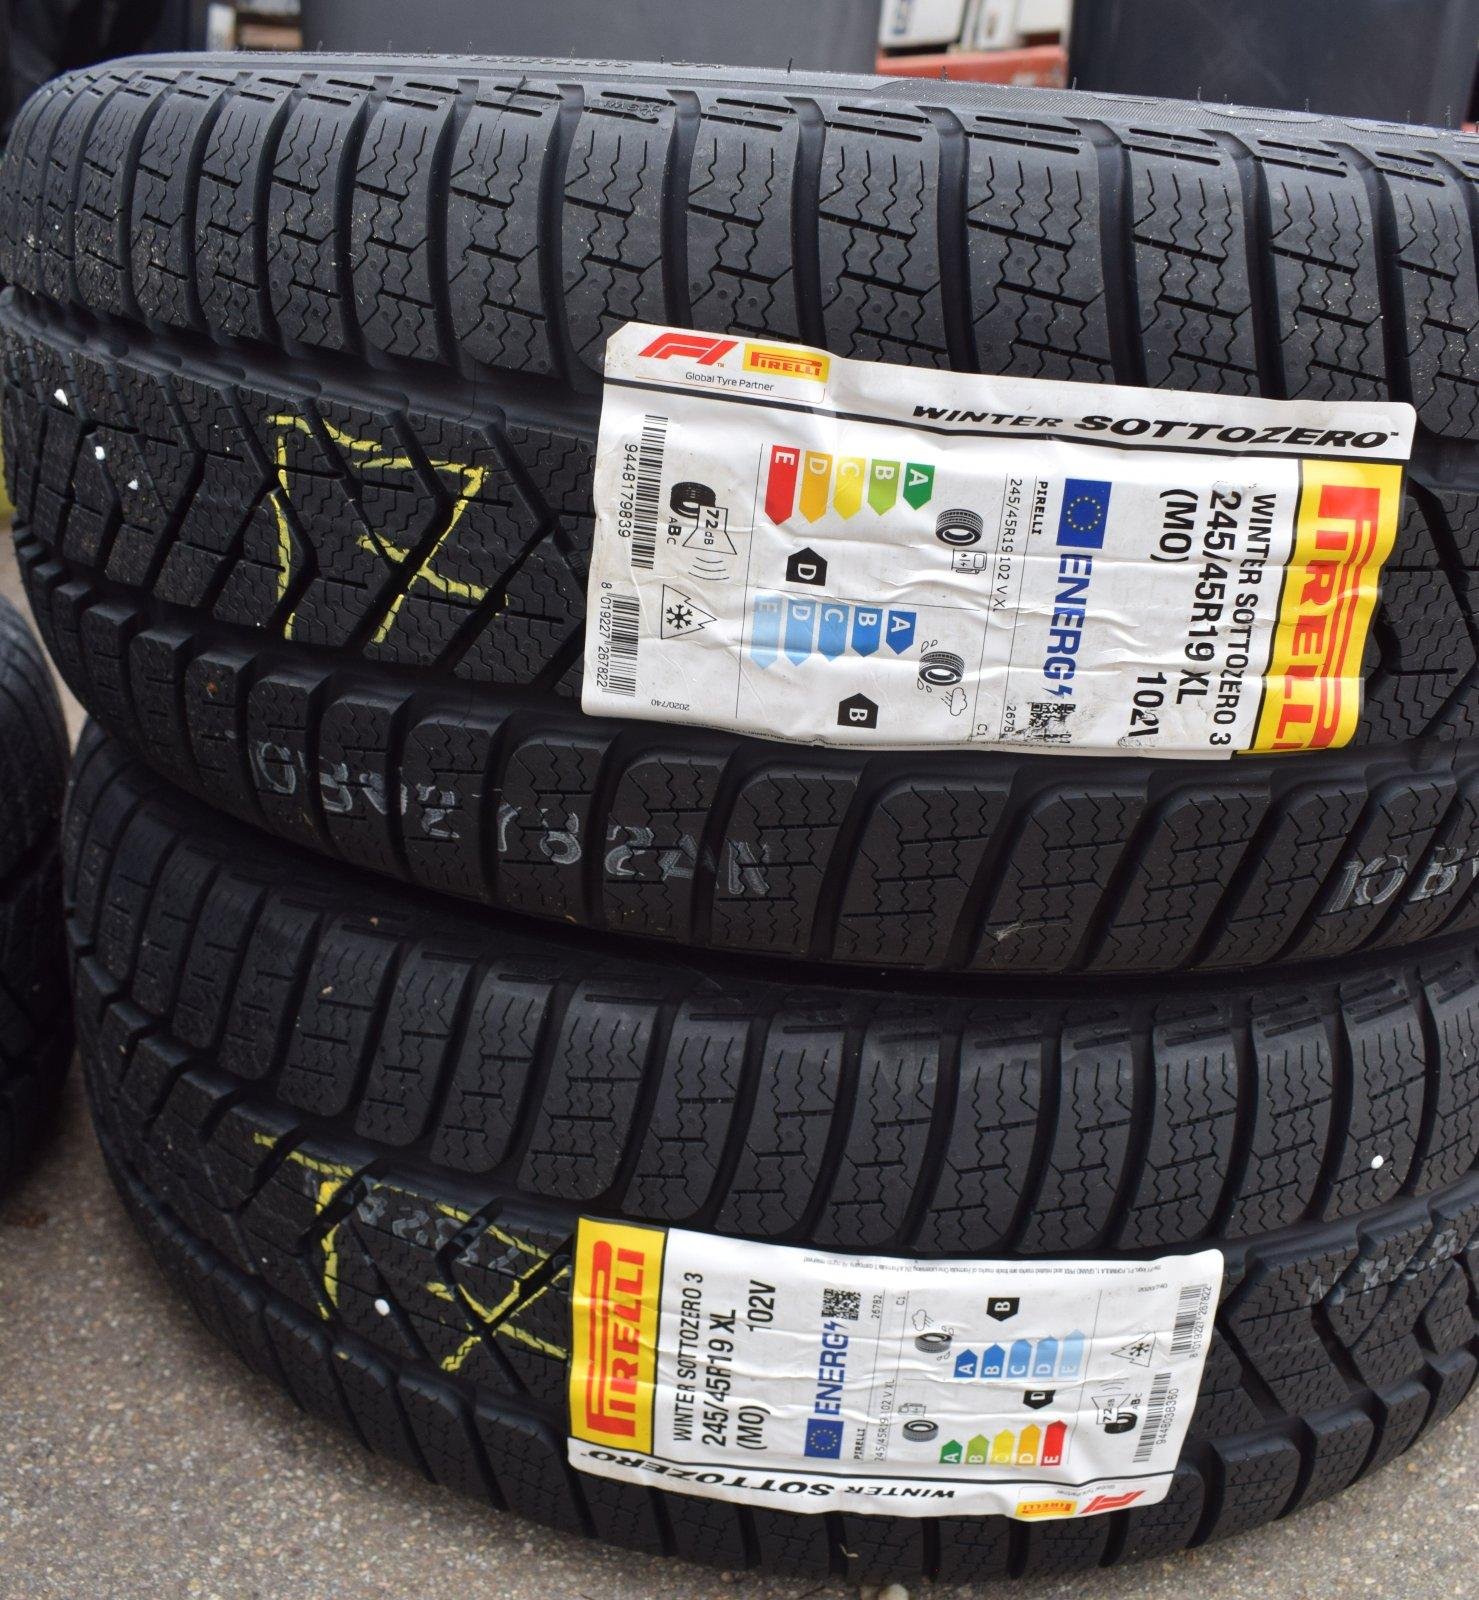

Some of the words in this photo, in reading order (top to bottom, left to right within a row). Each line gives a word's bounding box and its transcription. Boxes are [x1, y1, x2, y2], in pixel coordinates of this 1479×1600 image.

[638, 333, 738, 366] F1
[750, 352, 823, 377] PIRELLI
[685, 371, 714, 384] Global
[717, 375, 738, 388] Tyre
[739, 379, 774, 391] Partner
[911, 405, 1062, 428] WINTER
[775, 452, 795, 466] E
[809, 457, 828, 475] D
[840, 462, 860, 477] C
[875, 465, 895, 480] B
[909, 468, 929, 487] A
[618, 443, 639, 538] 9448179839
[1002, 479, 1022, 553] 245/45R19
[1032, 481, 1048, 535] PIRELLI
[1150, 489, 1199, 562] (MO)
[1239, 493, 1277, 585] WINTER
[797, 563, 817, 580] D
[997, 557, 1011, 581] 102
[1184, 490, 1242, 662] 245/45R19
[599, 596, 612, 639] 019227
[792, 605, 810, 621] D
[825, 608, 844, 624] C
[858, 612, 878, 627] B
[891, 616, 911, 632] A
[596, 647, 610, 688] 267822
[1214, 593, 1259, 725] SOTTOZERO
[1176, 668, 1211, 705] XL
[651, 699, 690, 711] 2020/740
[849, 708, 867, 722] B
[976, 723, 988, 736] C1
[1209, 732, 1231, 746] 3
[684, 1272, 703, 1283] 3
[746, 1279, 776, 1332] 102V
[870, 1294, 883, 1319] 26782
[994, 1301, 1011, 1312] B
[709, 1309, 736, 1334] XL
[585, 1240, 645, 1437] PIRELLI
[677, 1288, 702, 1380] SOTTOZERO
[958, 1363, 974, 1375] A
[984, 1365, 1000, 1375] B
[1011, 1364, 1026, 1375] C
[1036, 1363, 1051, 1374] D
[702, 1338, 734, 1447] 245/45R19
[673, 1383, 695, 1441] WINTER
[737, 1405, 771, 1450] (MO)
[853, 1428, 866, 1460] PIRELLI
[944, 1453, 958, 1463] A
[969, 1455, 984, 1464] B
[1019, 1453, 1034, 1464] D
[1044, 1455, 1059, 1464] E
[844, 1485, 955, 1499] WINTER
